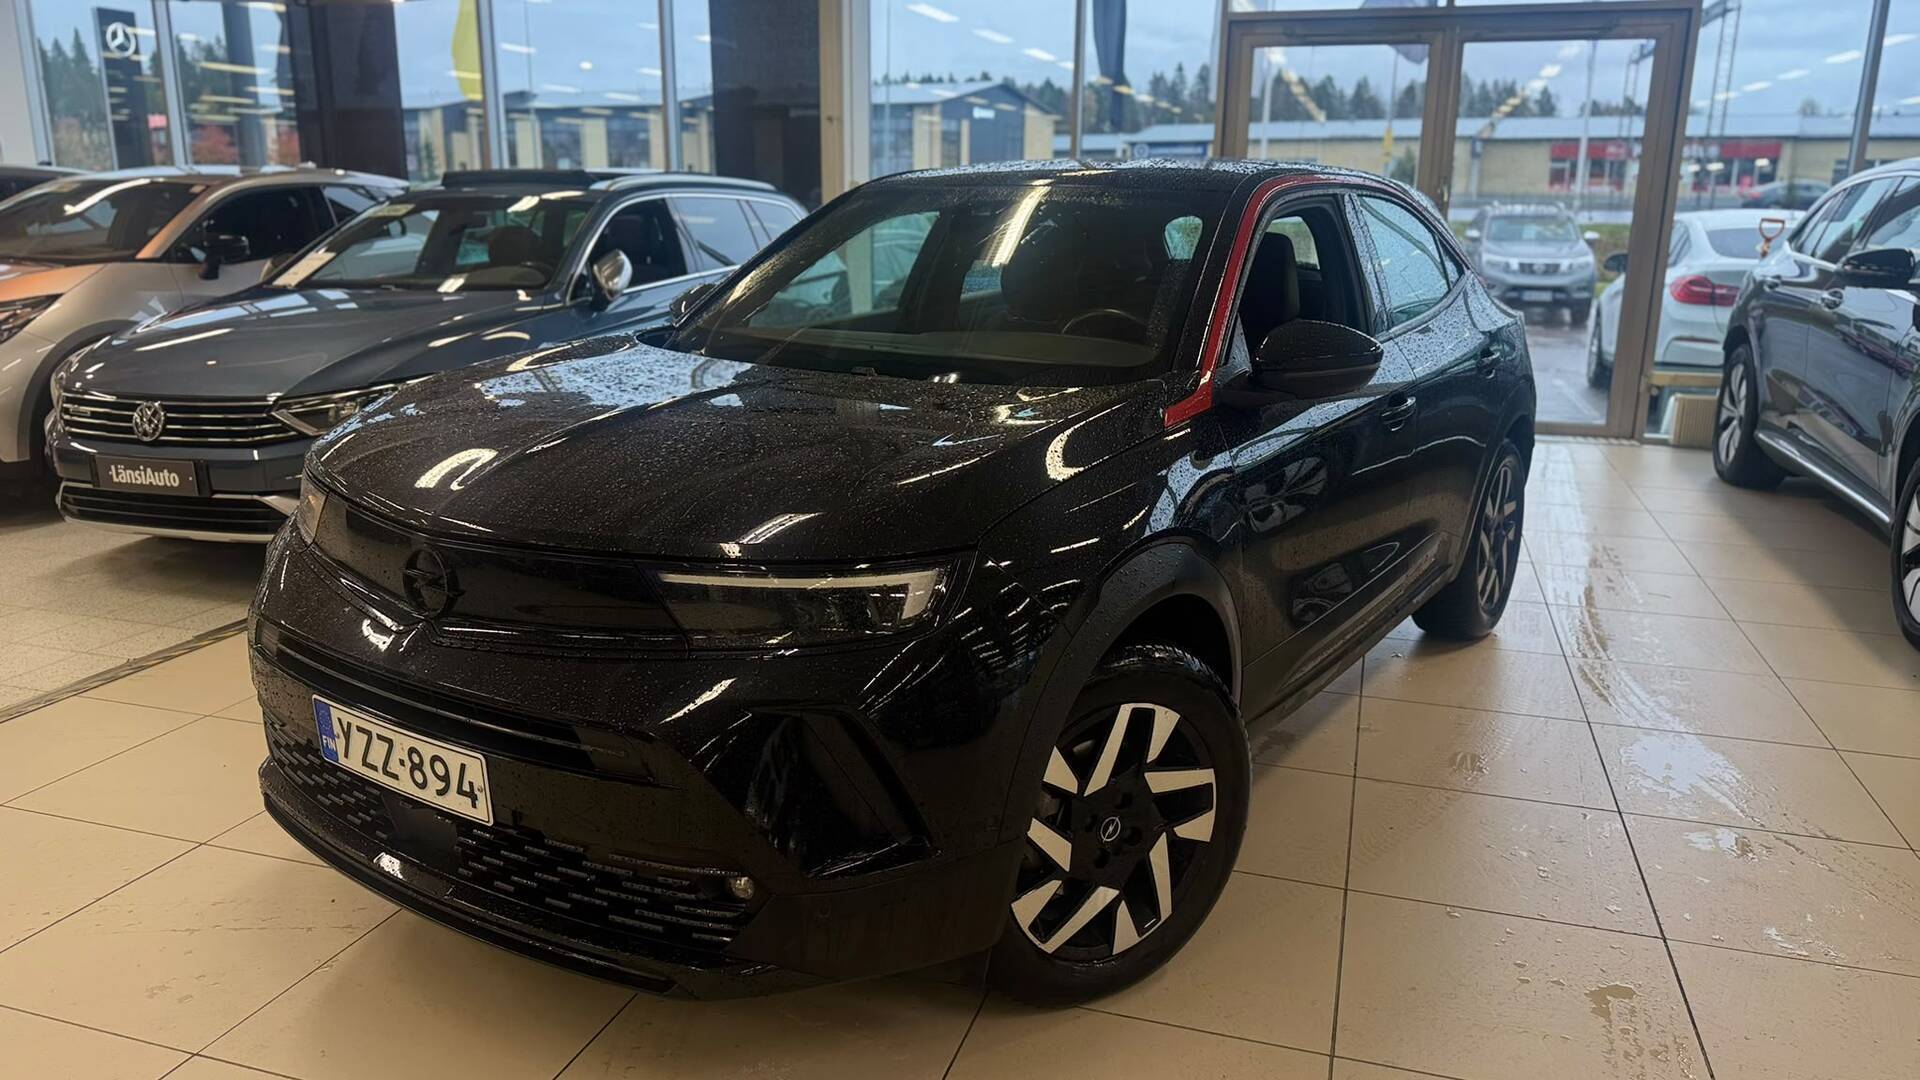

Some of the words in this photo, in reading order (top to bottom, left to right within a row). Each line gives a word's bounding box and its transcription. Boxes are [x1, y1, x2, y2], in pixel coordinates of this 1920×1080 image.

[110, 464, 180, 487] LänsiAuto
[322, 735, 337, 751] FIN
[337, 717, 478, 809] YZZ-894
